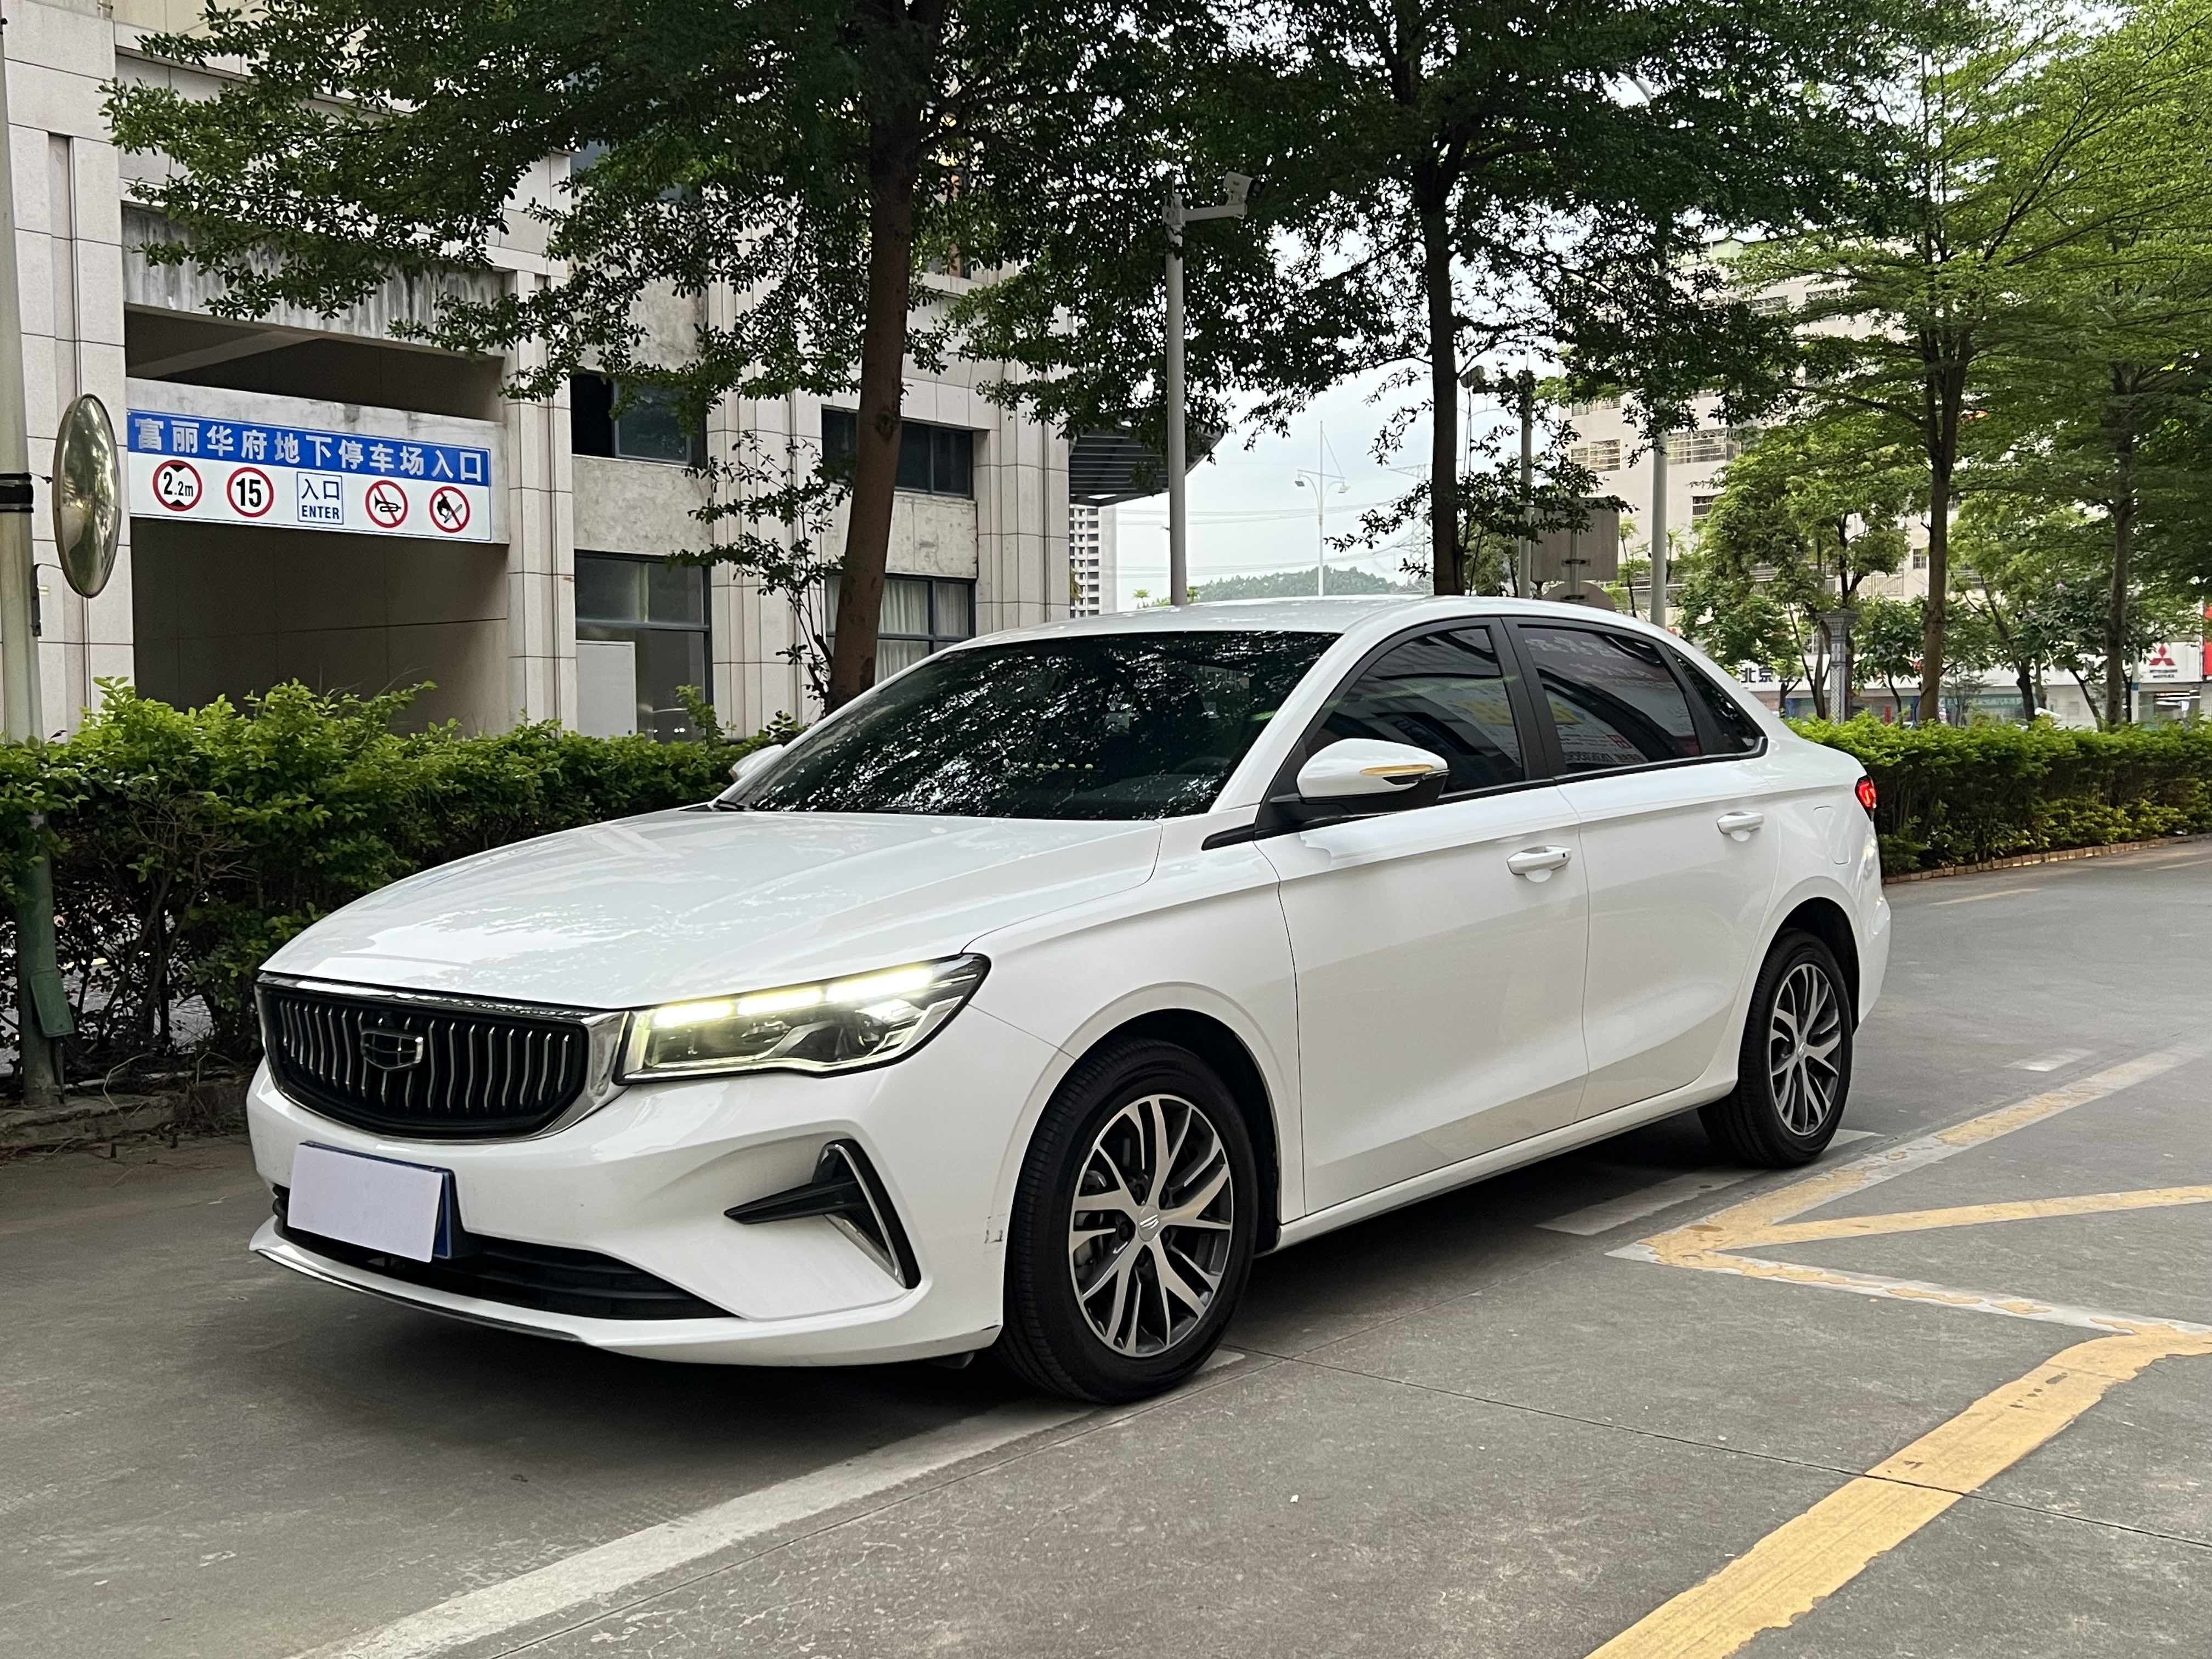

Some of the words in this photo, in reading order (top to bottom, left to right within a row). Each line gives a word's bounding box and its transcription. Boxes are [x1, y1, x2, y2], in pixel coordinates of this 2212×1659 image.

[135, 419, 482, 482] 富丽华府地下停车场入口
[163, 471, 194, 498] 2.2m
[236, 478, 262, 507] 15
[301, 478, 340, 500] 入口
[302, 505, 340, 520] ENTER
